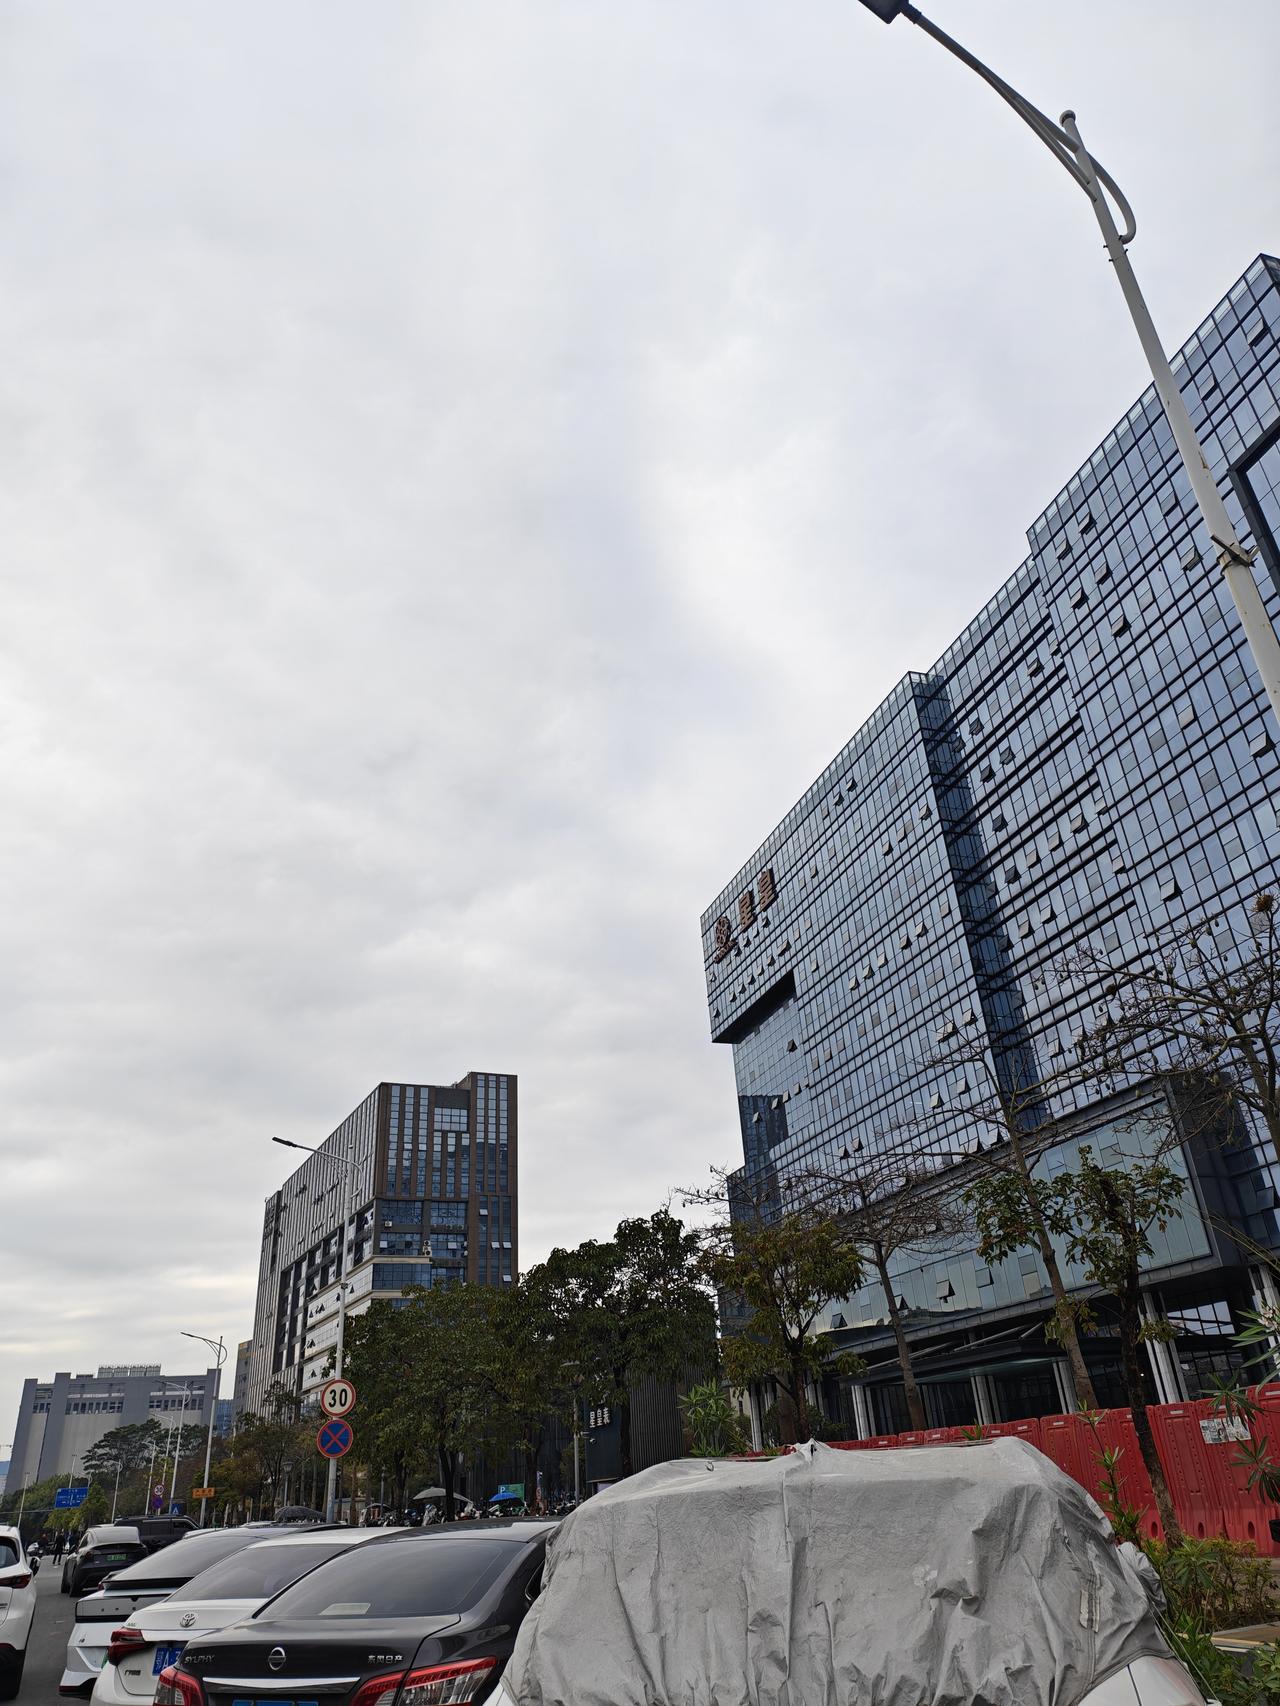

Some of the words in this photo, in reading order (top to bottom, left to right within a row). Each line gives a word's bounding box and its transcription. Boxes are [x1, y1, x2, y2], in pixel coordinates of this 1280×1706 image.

[328, 1388, 348, 1408] 30
[367, 1654, 403, 1664] 东风日产
